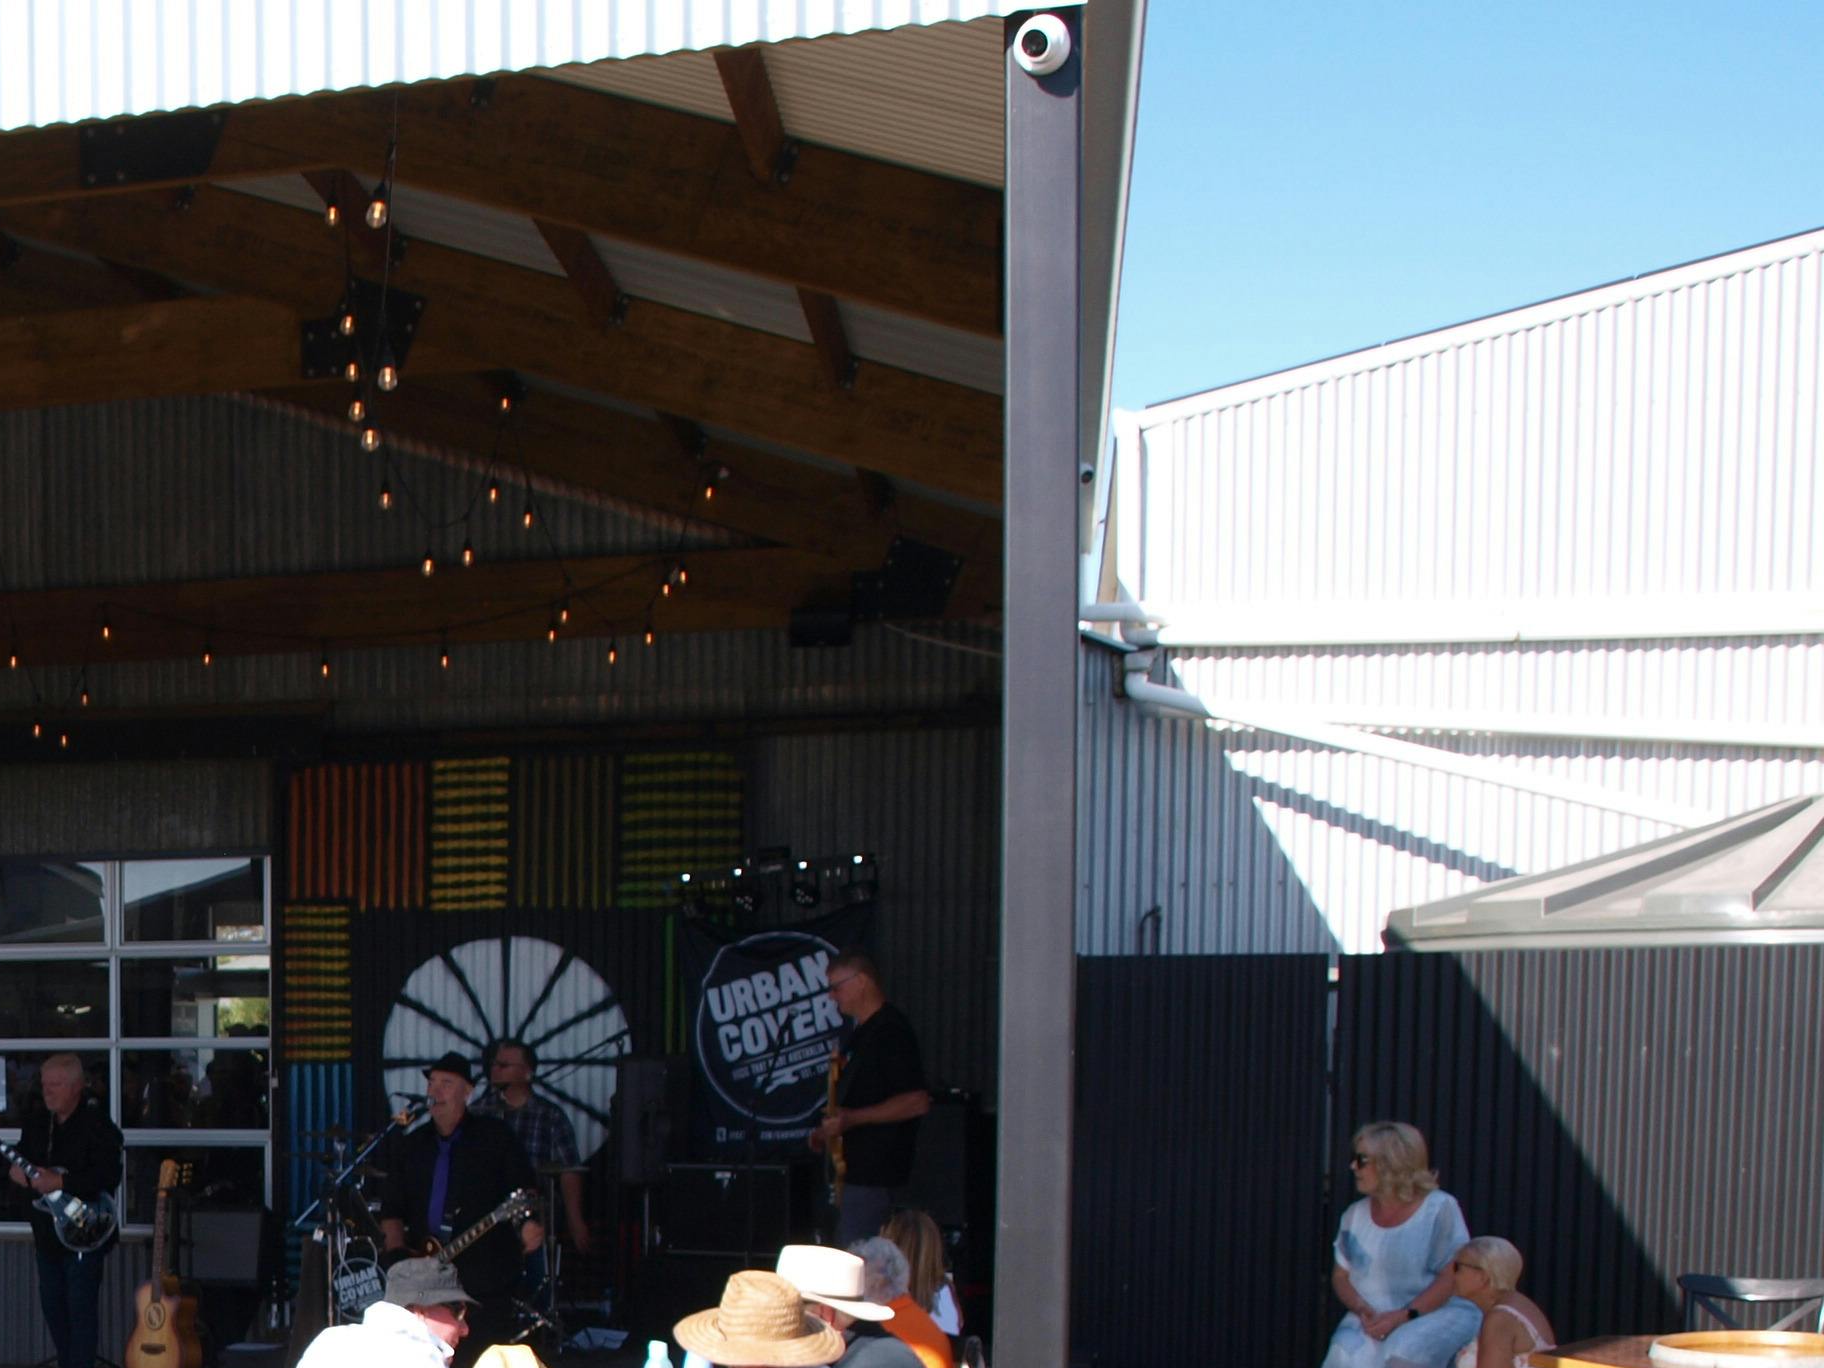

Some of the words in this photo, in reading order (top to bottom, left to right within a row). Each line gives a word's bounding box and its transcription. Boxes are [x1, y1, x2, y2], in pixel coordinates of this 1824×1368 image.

[706, 950, 830, 1024] URBAN
[717, 992, 844, 1063] COVER
[340, 1278, 382, 1303] COVER
